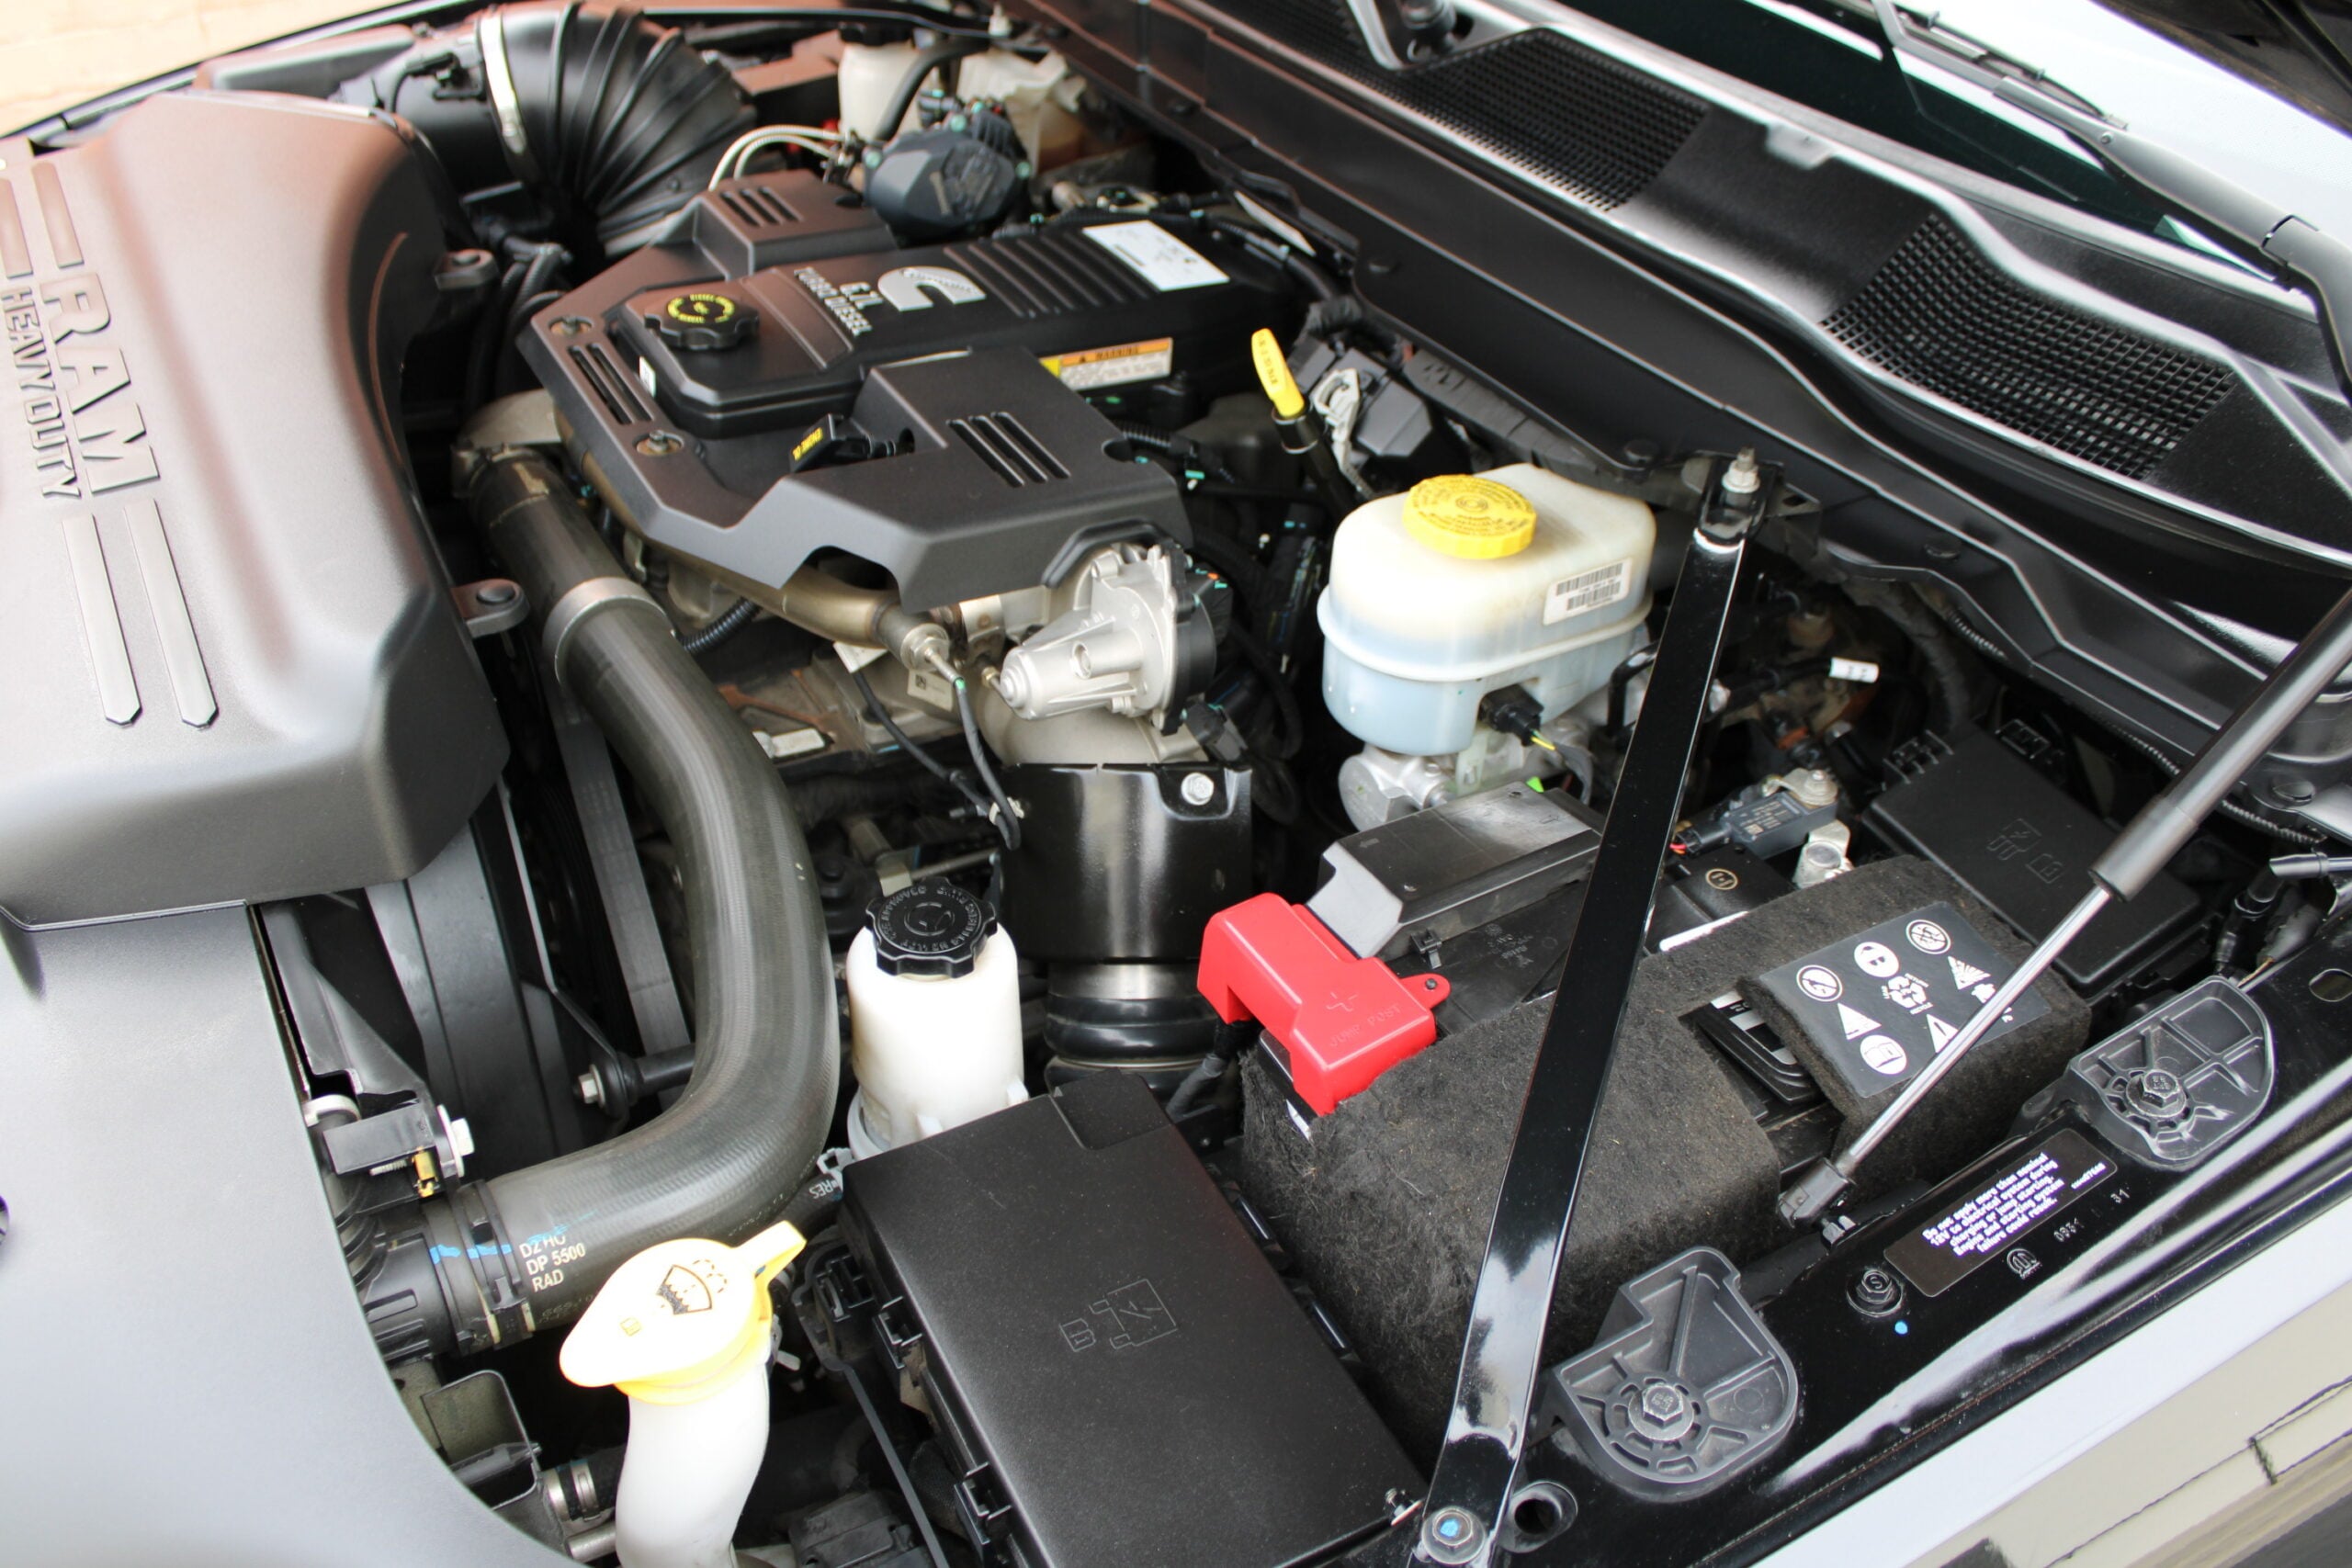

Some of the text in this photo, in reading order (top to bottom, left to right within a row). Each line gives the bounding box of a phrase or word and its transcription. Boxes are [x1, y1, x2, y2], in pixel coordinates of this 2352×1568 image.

[824, 296, 873, 337] DIESEL
[1, 286, 83, 499] HEAVY DUTY
[40, 272, 160, 496] RAM
[526, 1242, 586, 1276] DP 5500
[531, 1269, 565, 1293] RAD
